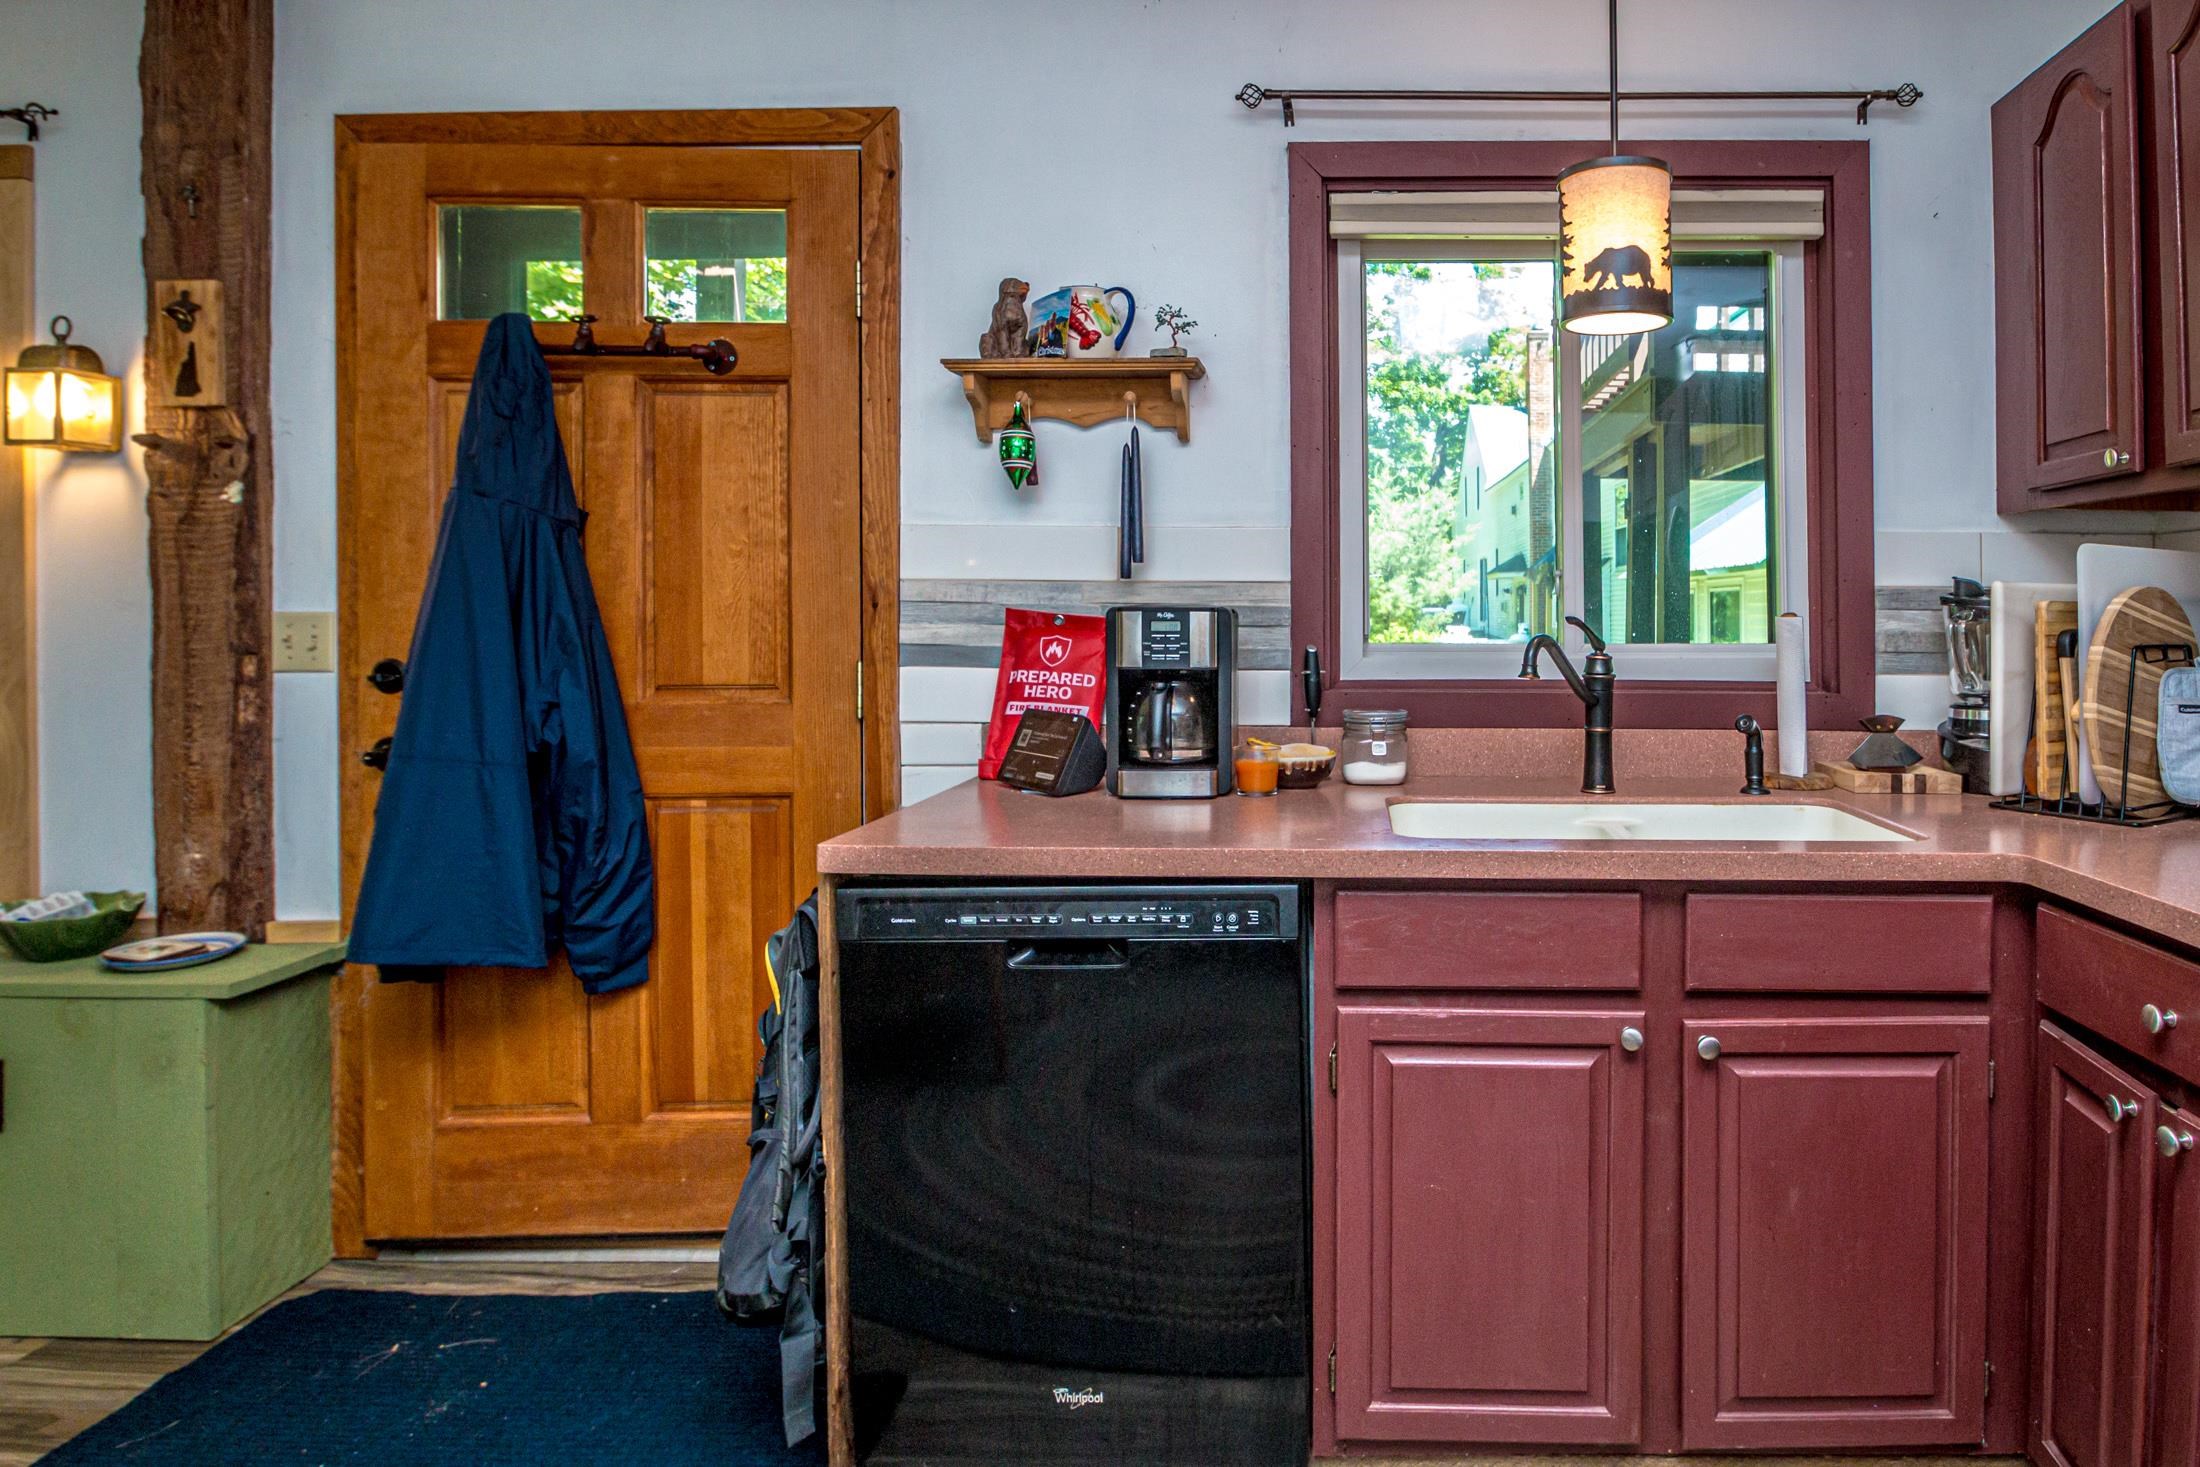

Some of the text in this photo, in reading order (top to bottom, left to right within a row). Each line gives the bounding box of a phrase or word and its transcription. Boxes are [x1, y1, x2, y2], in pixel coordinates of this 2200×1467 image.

[1009, 669, 1096, 688] PREPARED
[1023, 685, 1072, 700] HERO
[1053, 1389, 1104, 1406] Whirlpool
